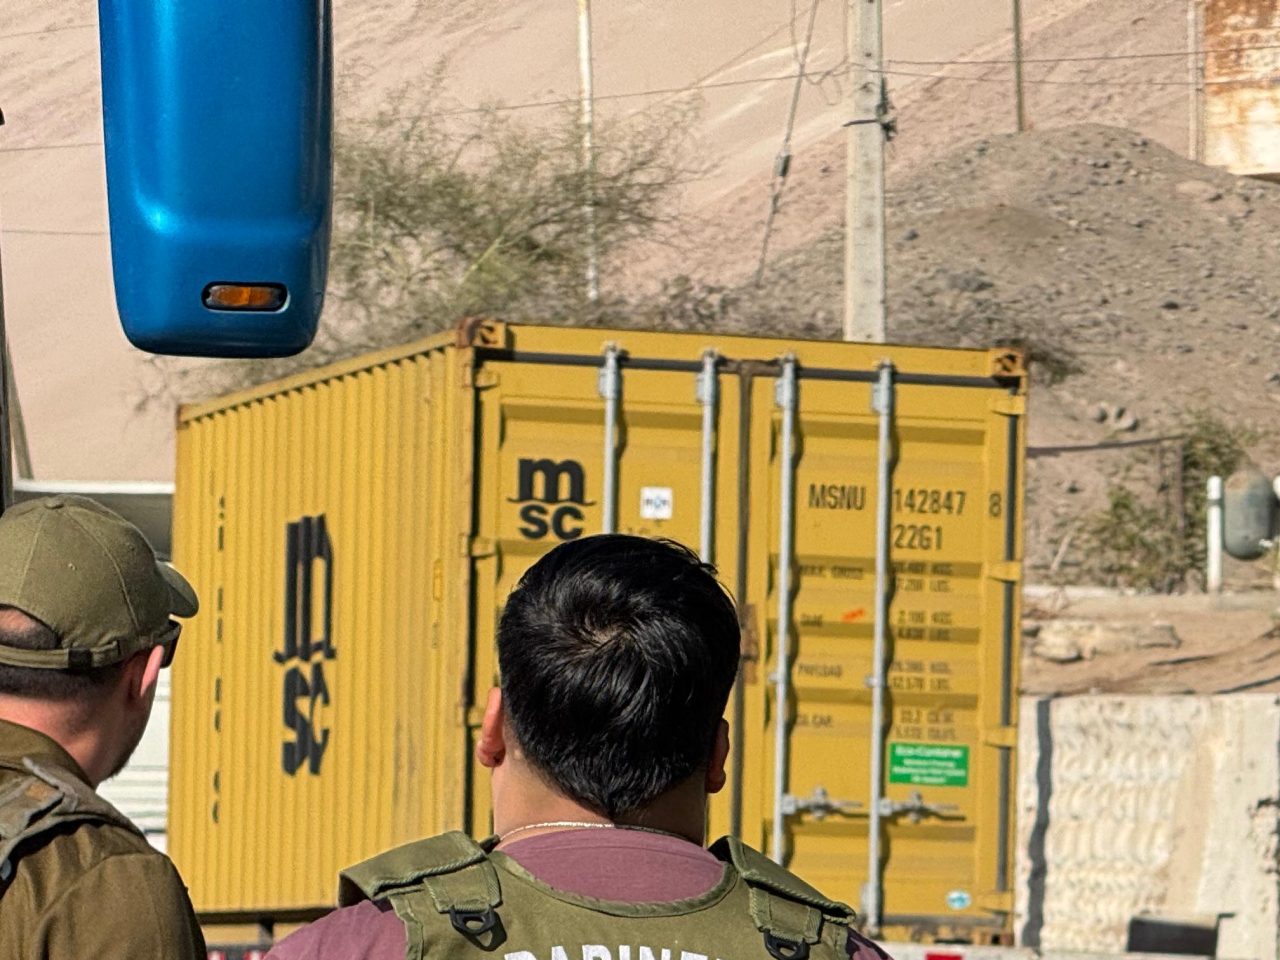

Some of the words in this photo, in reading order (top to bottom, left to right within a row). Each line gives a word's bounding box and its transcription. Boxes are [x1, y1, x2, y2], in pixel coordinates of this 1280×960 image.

[808, 483, 867, 511] MSNU
[893, 488, 967, 515] 142847
[988, 492, 1003, 518] 8
[893, 523, 942, 550] 22G1
